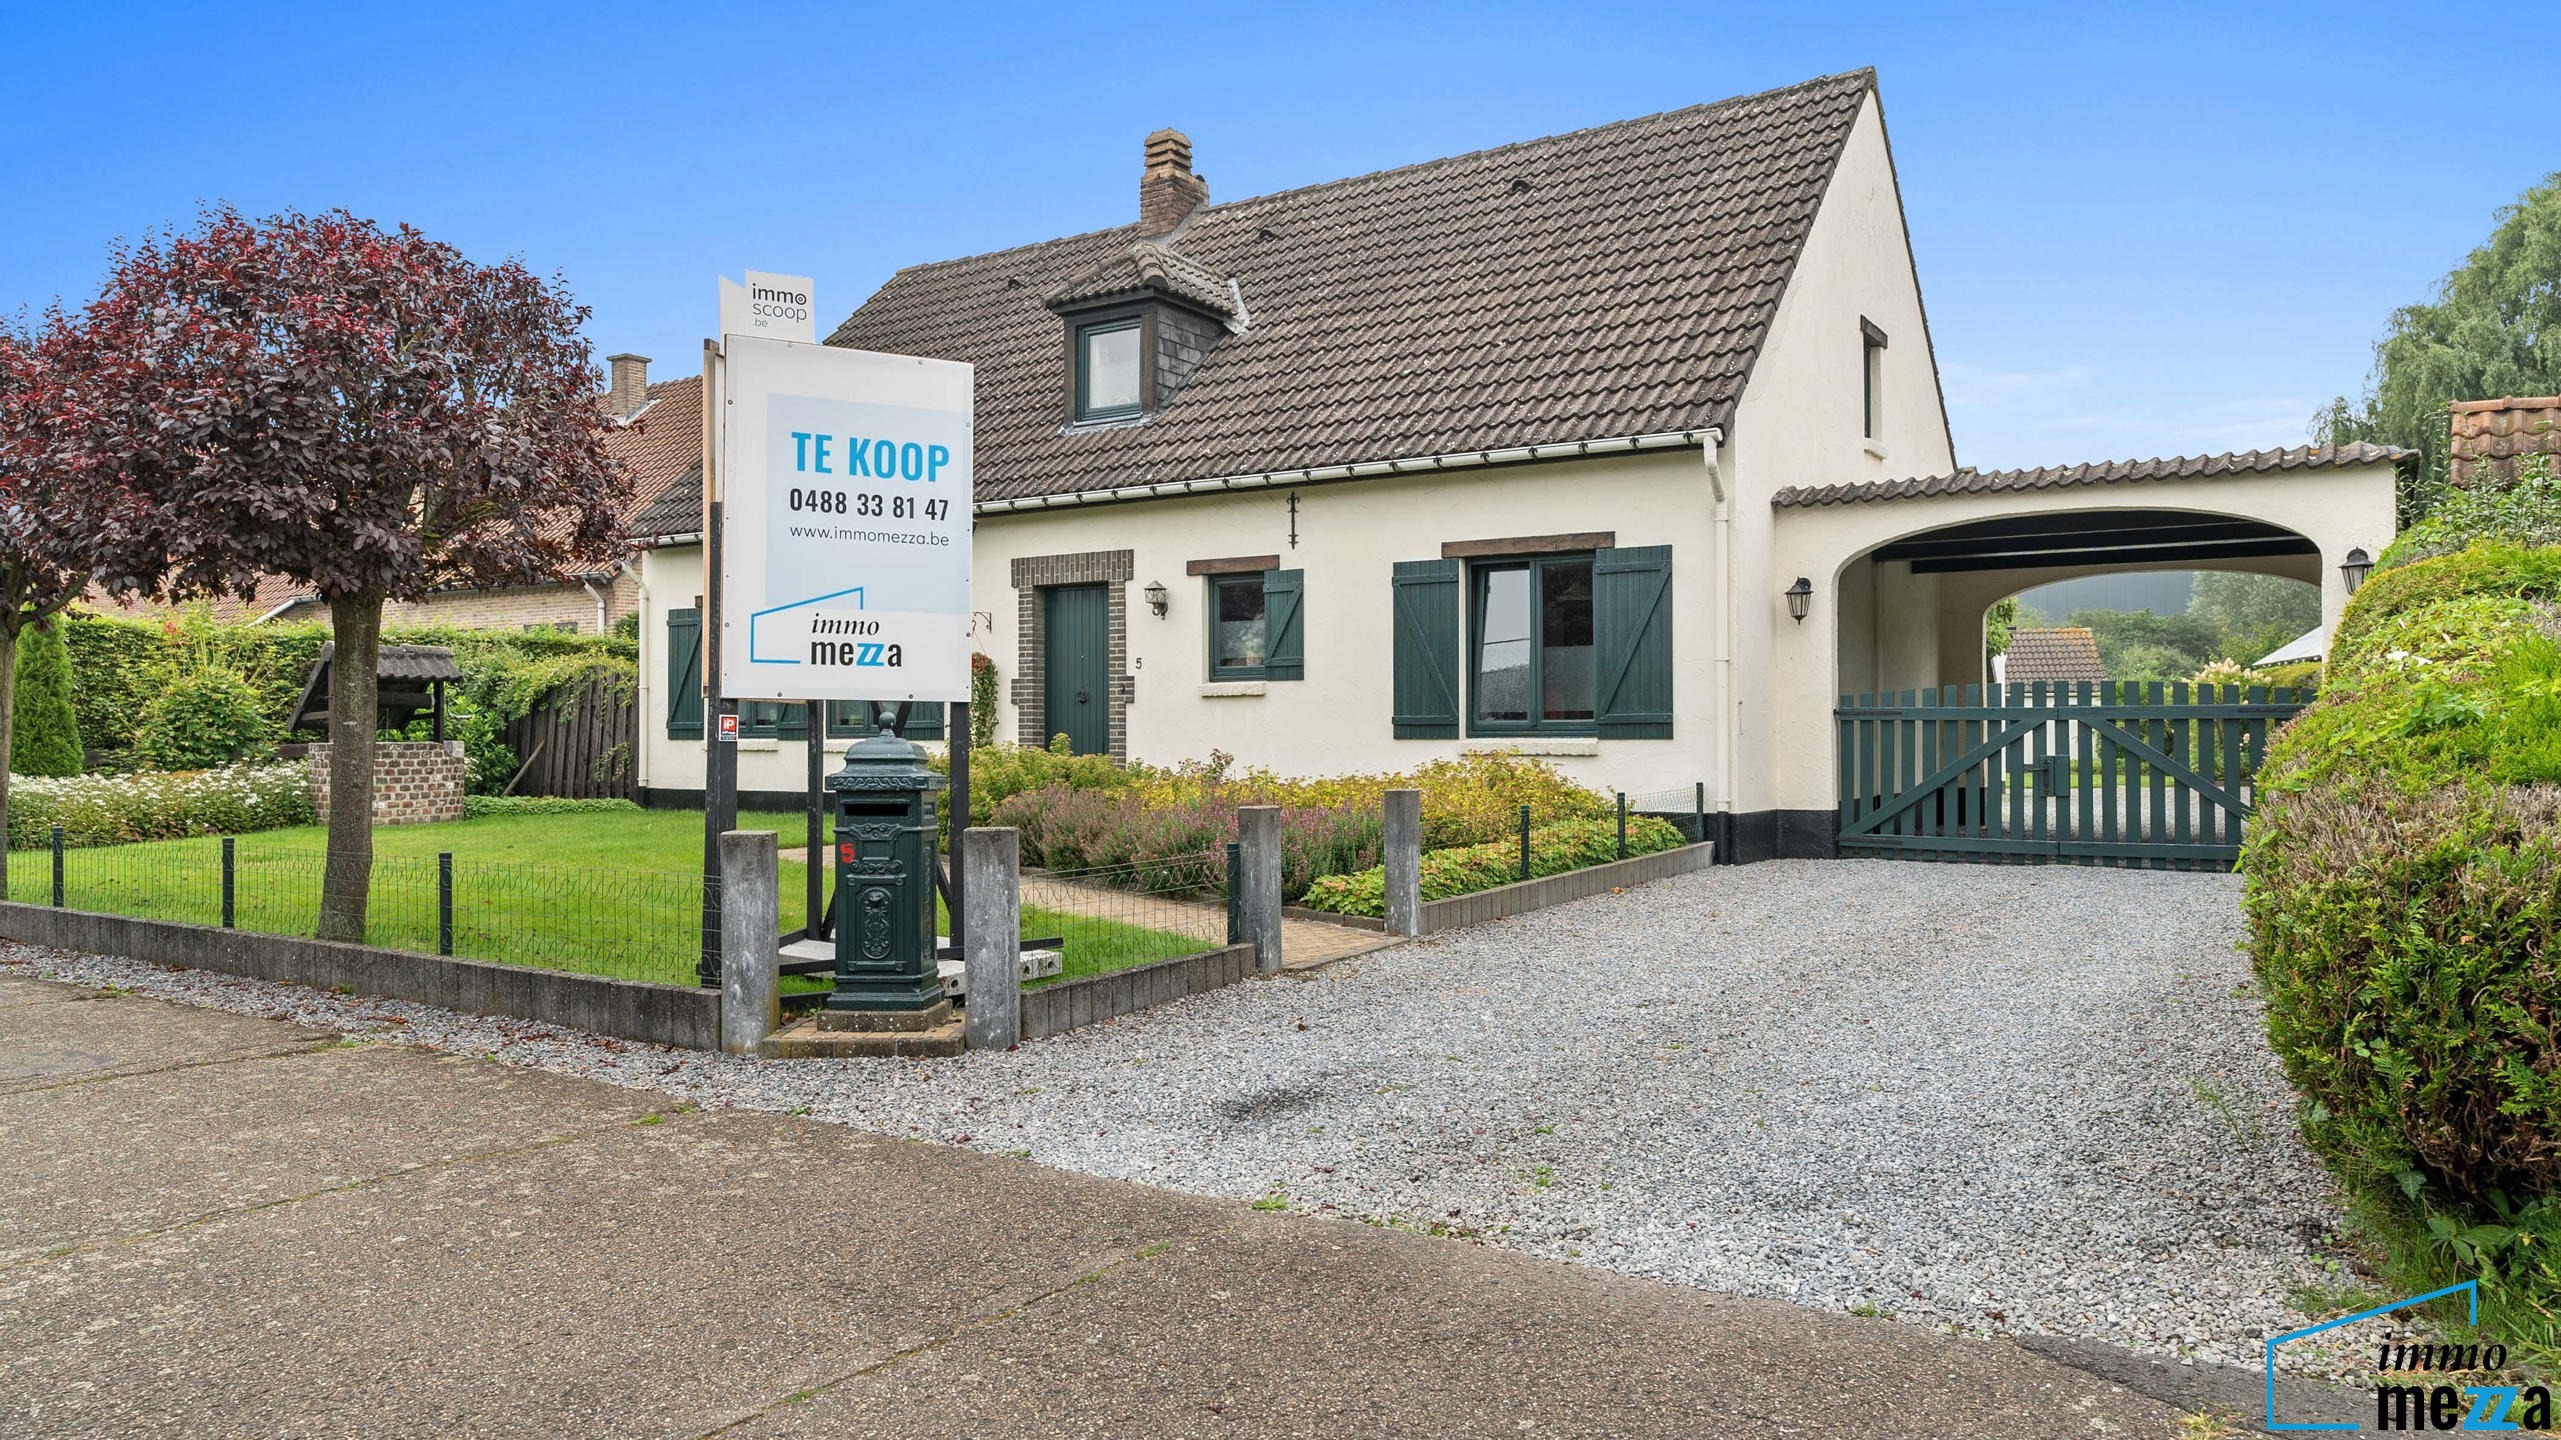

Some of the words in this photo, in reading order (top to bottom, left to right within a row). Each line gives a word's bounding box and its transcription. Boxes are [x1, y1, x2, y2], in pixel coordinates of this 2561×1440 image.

[752, 282, 807, 305] immo
[752, 303, 807, 323] scoop
[752, 317, 768, 328] .be
[791, 432, 832, 473] TE
[849, 437, 950, 482] KOOP
[789, 488, 847, 514] 0488
[857, 493, 883, 517] 33
[893, 496, 915, 519] 81
[925, 498, 949, 521] 47
[790, 526, 949, 547] www.immomezza.be
[811, 613, 879, 636] immo
[811, 641, 902, 667] mezza
[1135, 657, 1143, 670] 5
[840, 843, 855, 864] 5
